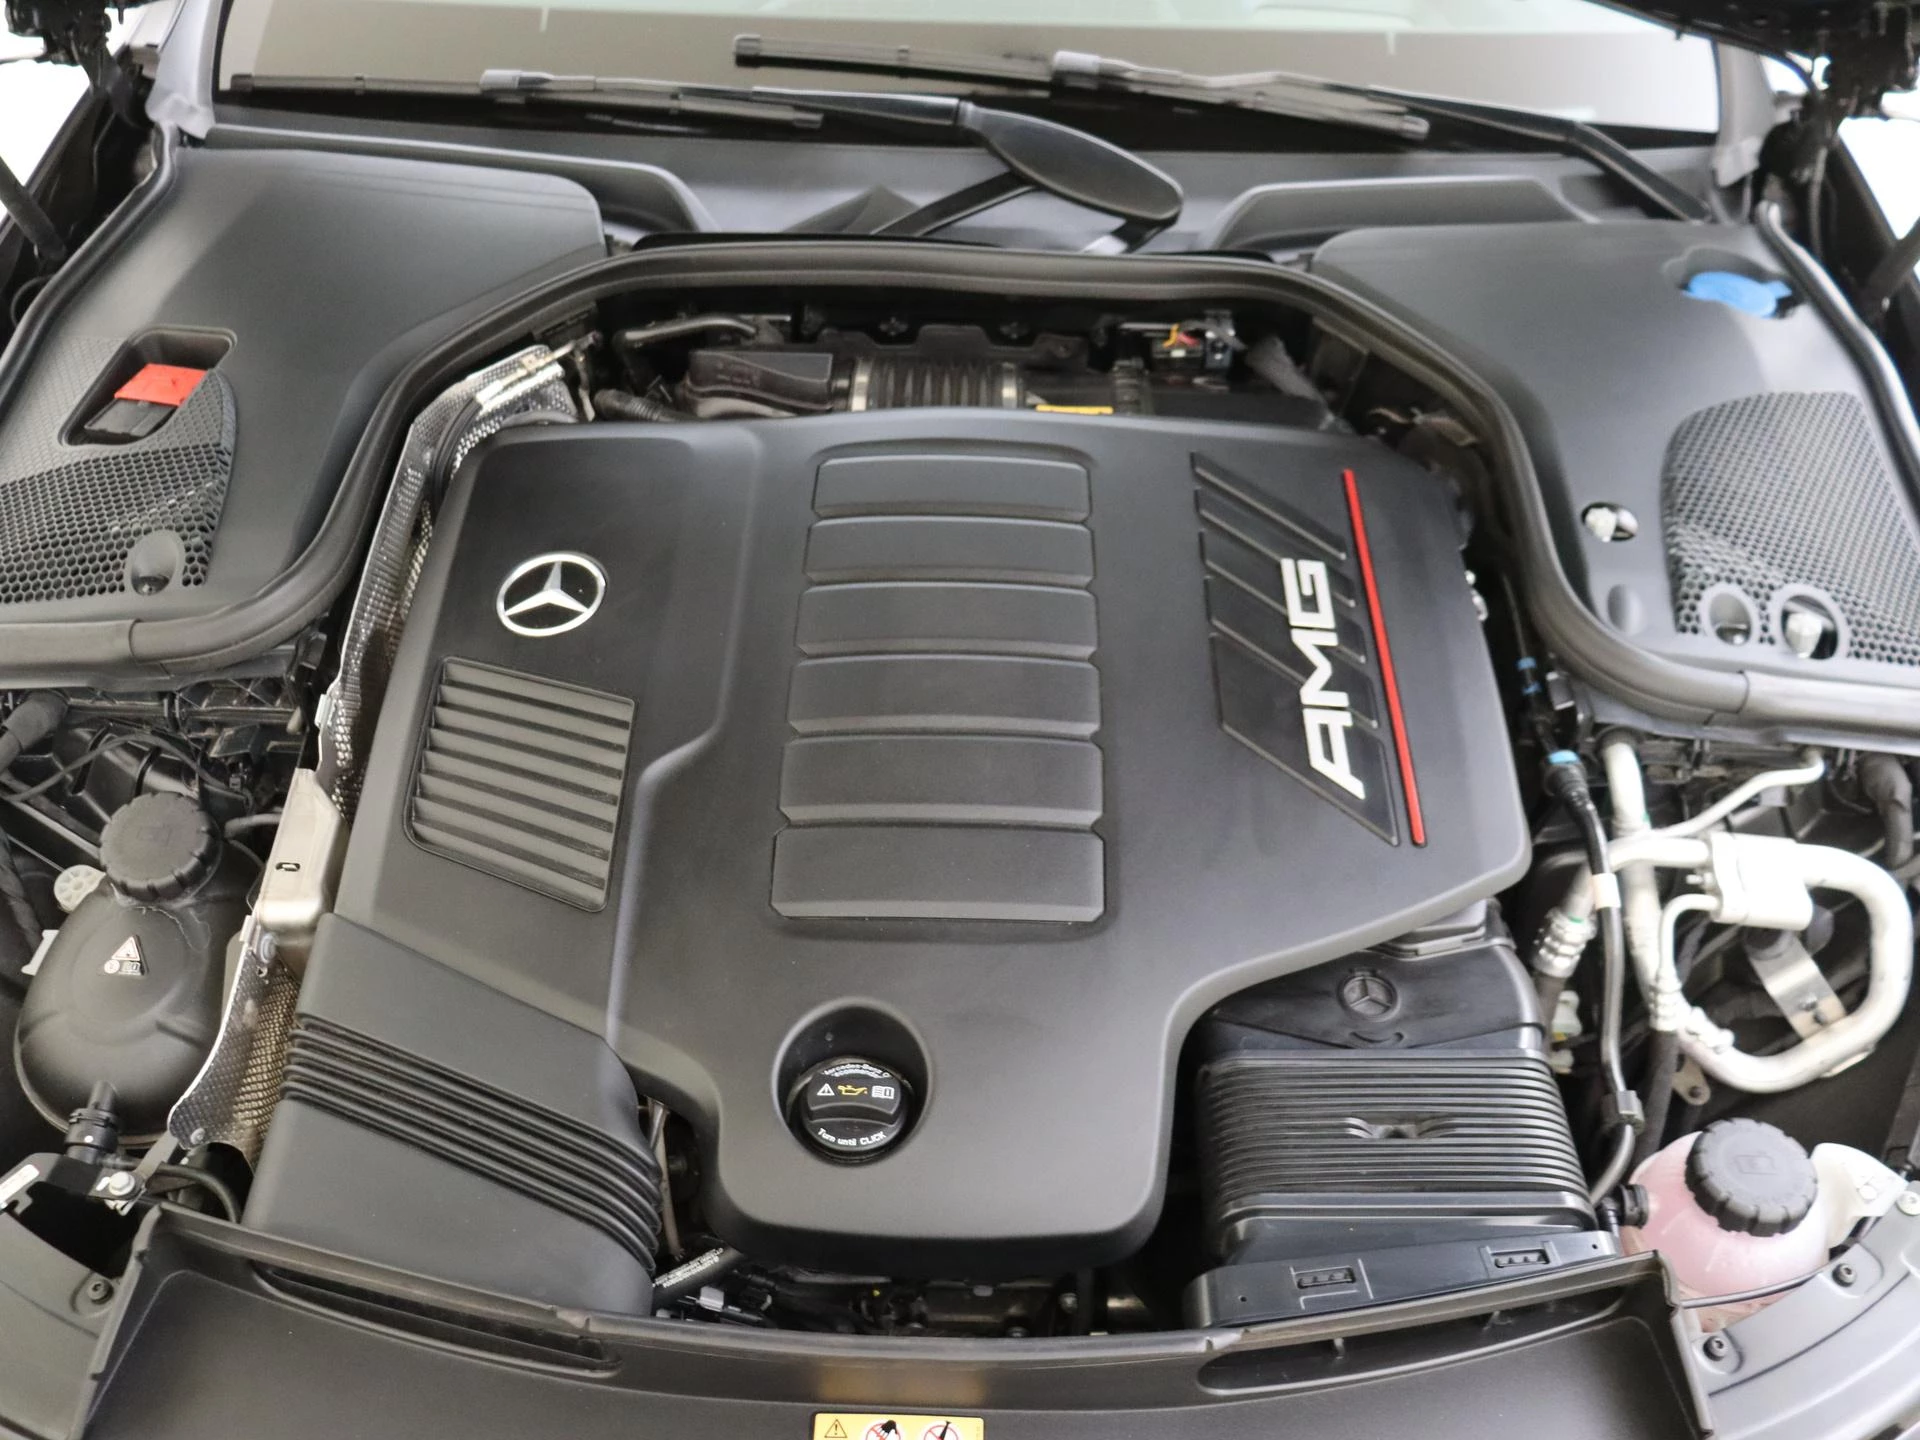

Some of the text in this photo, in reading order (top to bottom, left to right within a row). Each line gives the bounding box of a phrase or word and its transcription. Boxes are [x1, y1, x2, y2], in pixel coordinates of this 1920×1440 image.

[1280, 557, 1366, 800] AMG
[818, 1127, 886, 1146] Turn until CLICK
